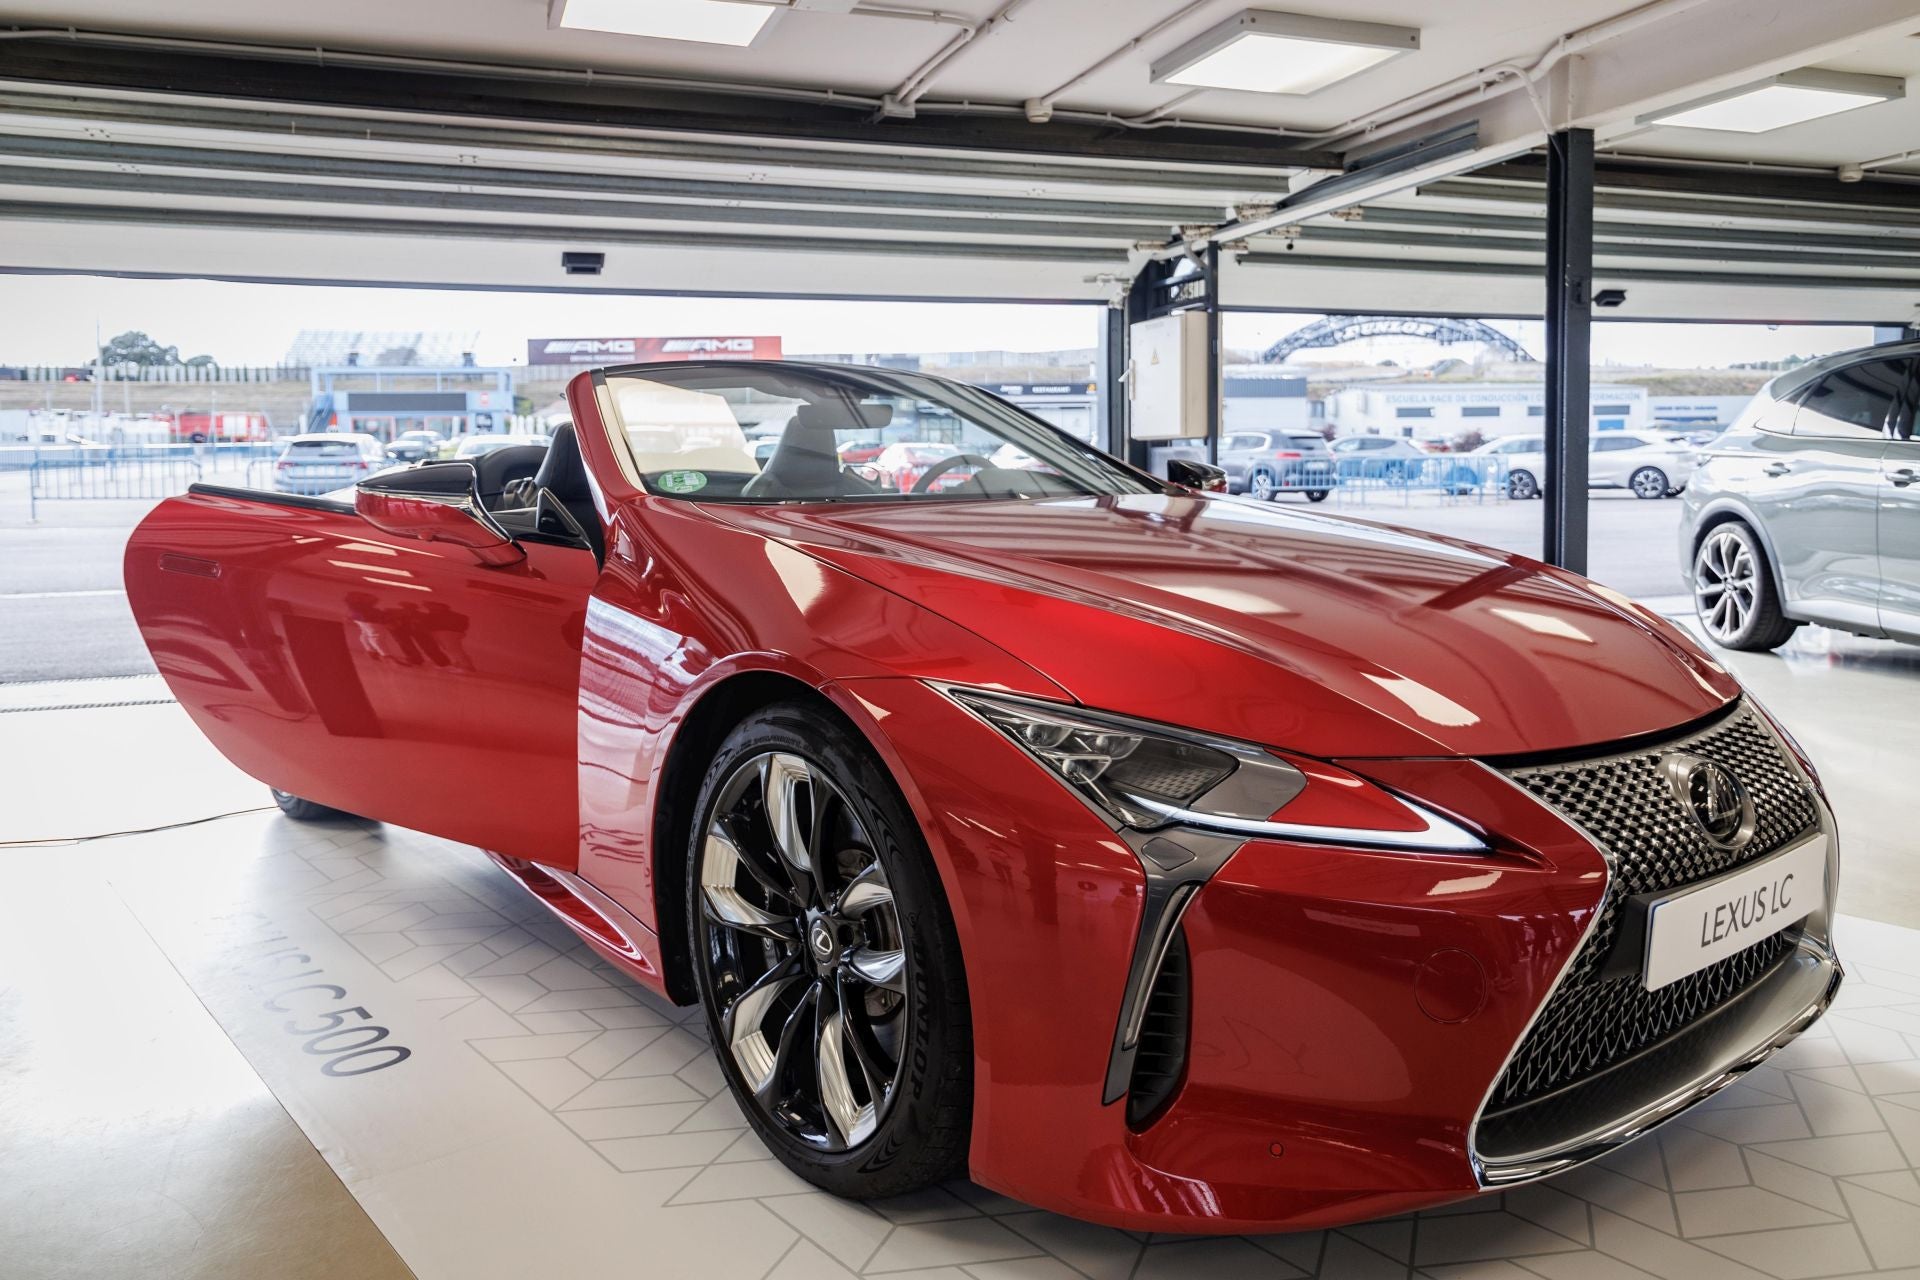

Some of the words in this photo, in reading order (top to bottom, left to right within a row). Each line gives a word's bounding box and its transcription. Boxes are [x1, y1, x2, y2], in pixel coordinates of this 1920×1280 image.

[1342, 320, 1437, 339] DUNLOP
[566, 340, 636, 354] AMG
[684, 339, 754, 353] AMG
[1701, 886, 1767, 948] LEXUS
[1771, 873, 1794, 915] LC
[911, 938, 929, 1100] DUNLOP
